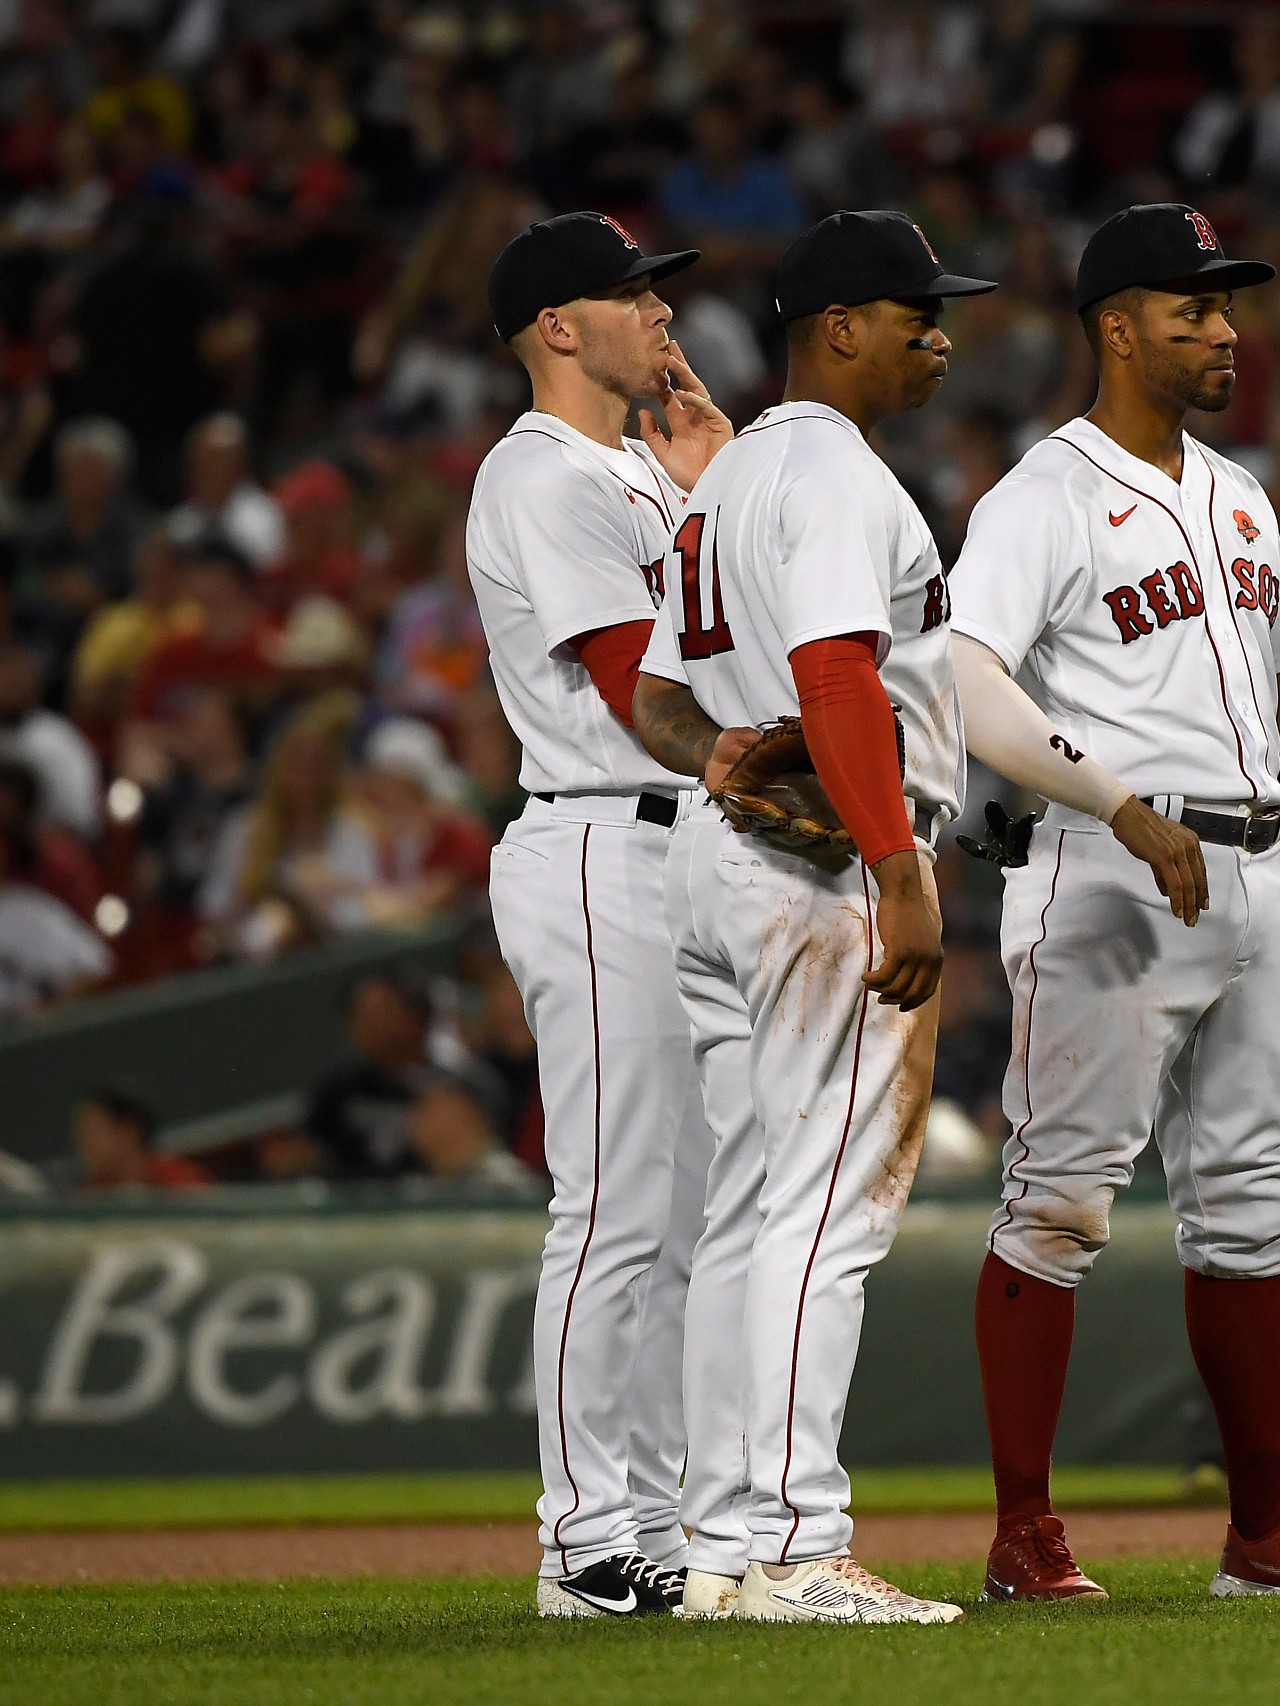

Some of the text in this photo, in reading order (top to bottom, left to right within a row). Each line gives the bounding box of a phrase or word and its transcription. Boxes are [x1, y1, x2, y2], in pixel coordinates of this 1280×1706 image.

[1184, 212, 1216, 251] B
[1102, 560, 1206, 645] RED
[1048, 733, 1086, 765] 2
